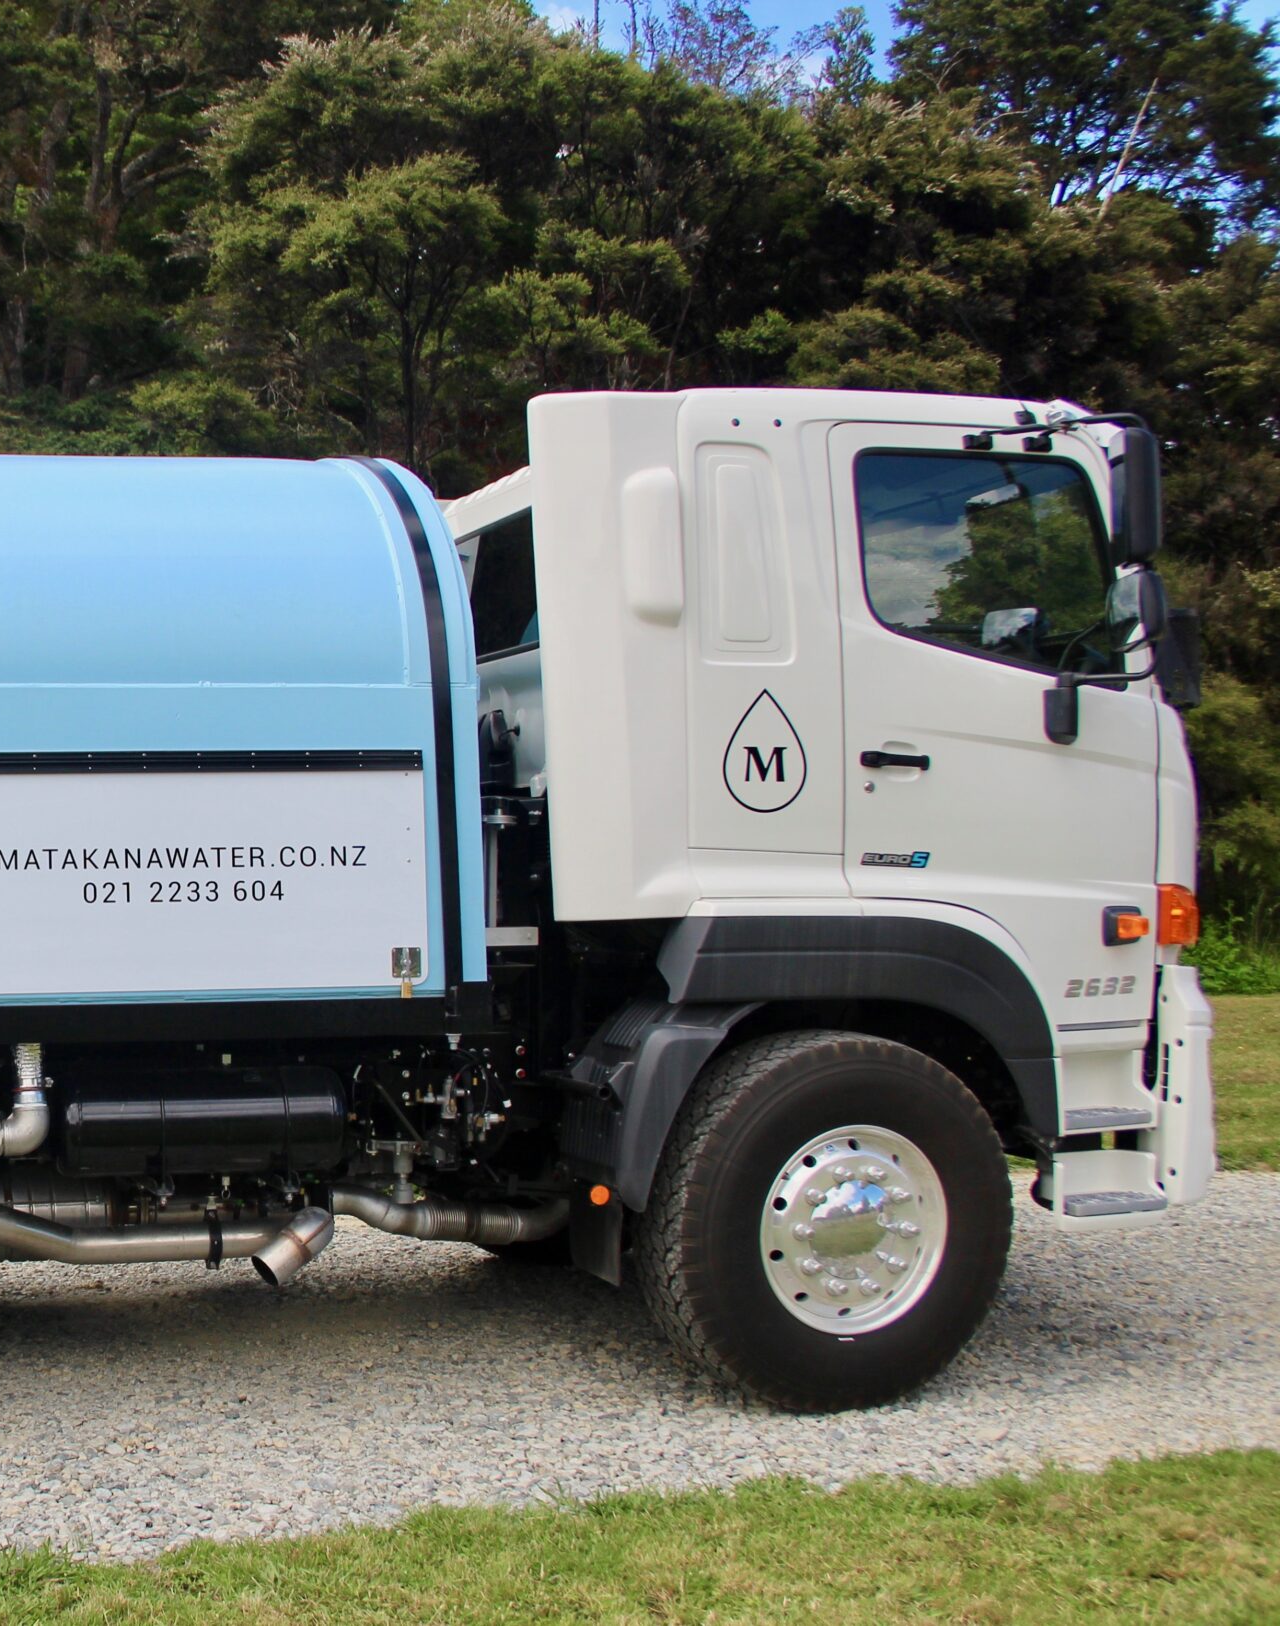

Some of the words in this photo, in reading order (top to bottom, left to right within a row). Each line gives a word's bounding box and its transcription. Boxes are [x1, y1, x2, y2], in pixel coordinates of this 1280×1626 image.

[743, 745, 788, 783] M
[83, 881, 131, 904] 021
[149, 880, 219, 903] 2233
[233, 879, 285, 902] 604
[1064, 975, 1136, 999] 2632
